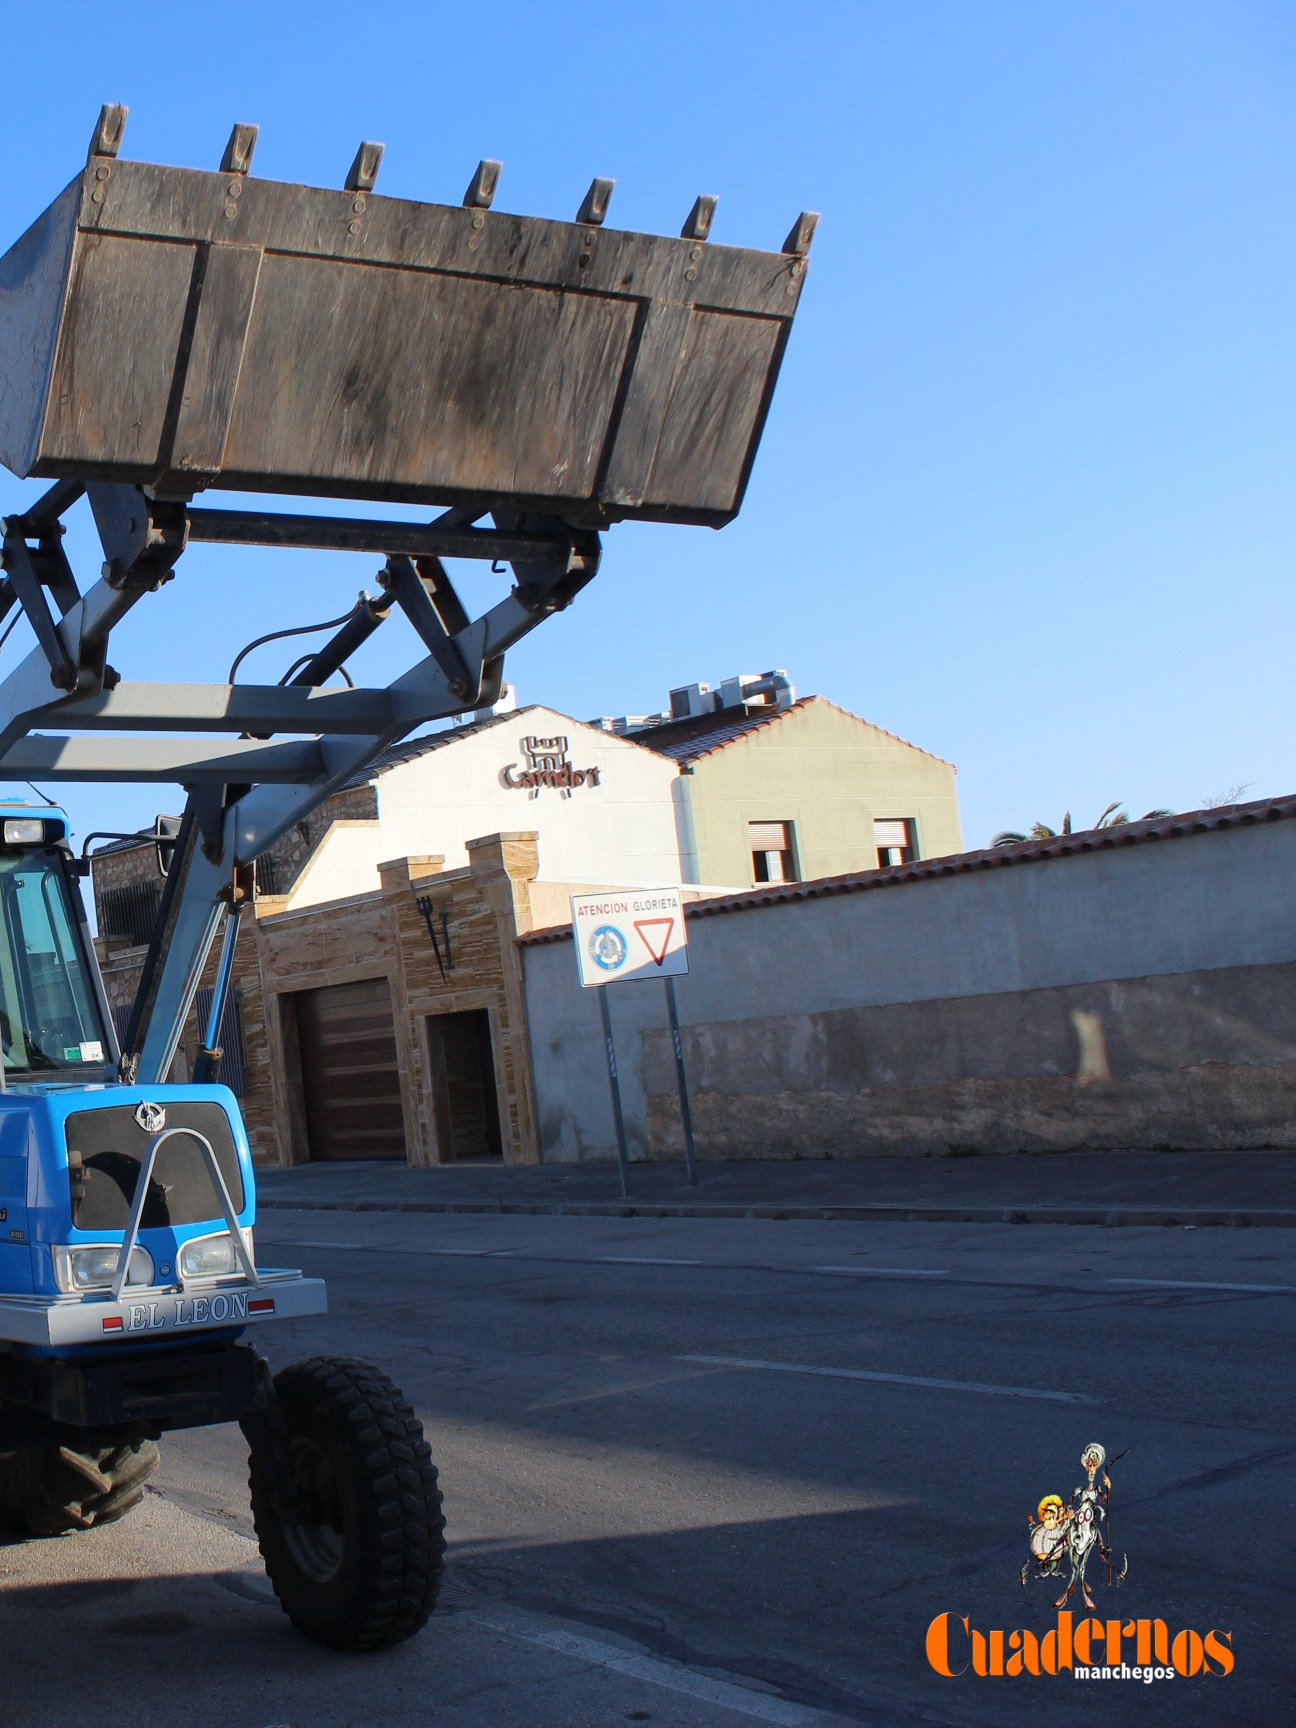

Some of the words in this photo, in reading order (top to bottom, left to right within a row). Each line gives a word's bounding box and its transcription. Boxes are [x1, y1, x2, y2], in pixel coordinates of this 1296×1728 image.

[502, 760, 601, 789] Camelot
[577, 902, 629, 917] ATENCION
[632, 898, 679, 912] GLORIETA
[127, 1303, 166, 1332] EL
[174, 1292, 249, 1326] LEON
